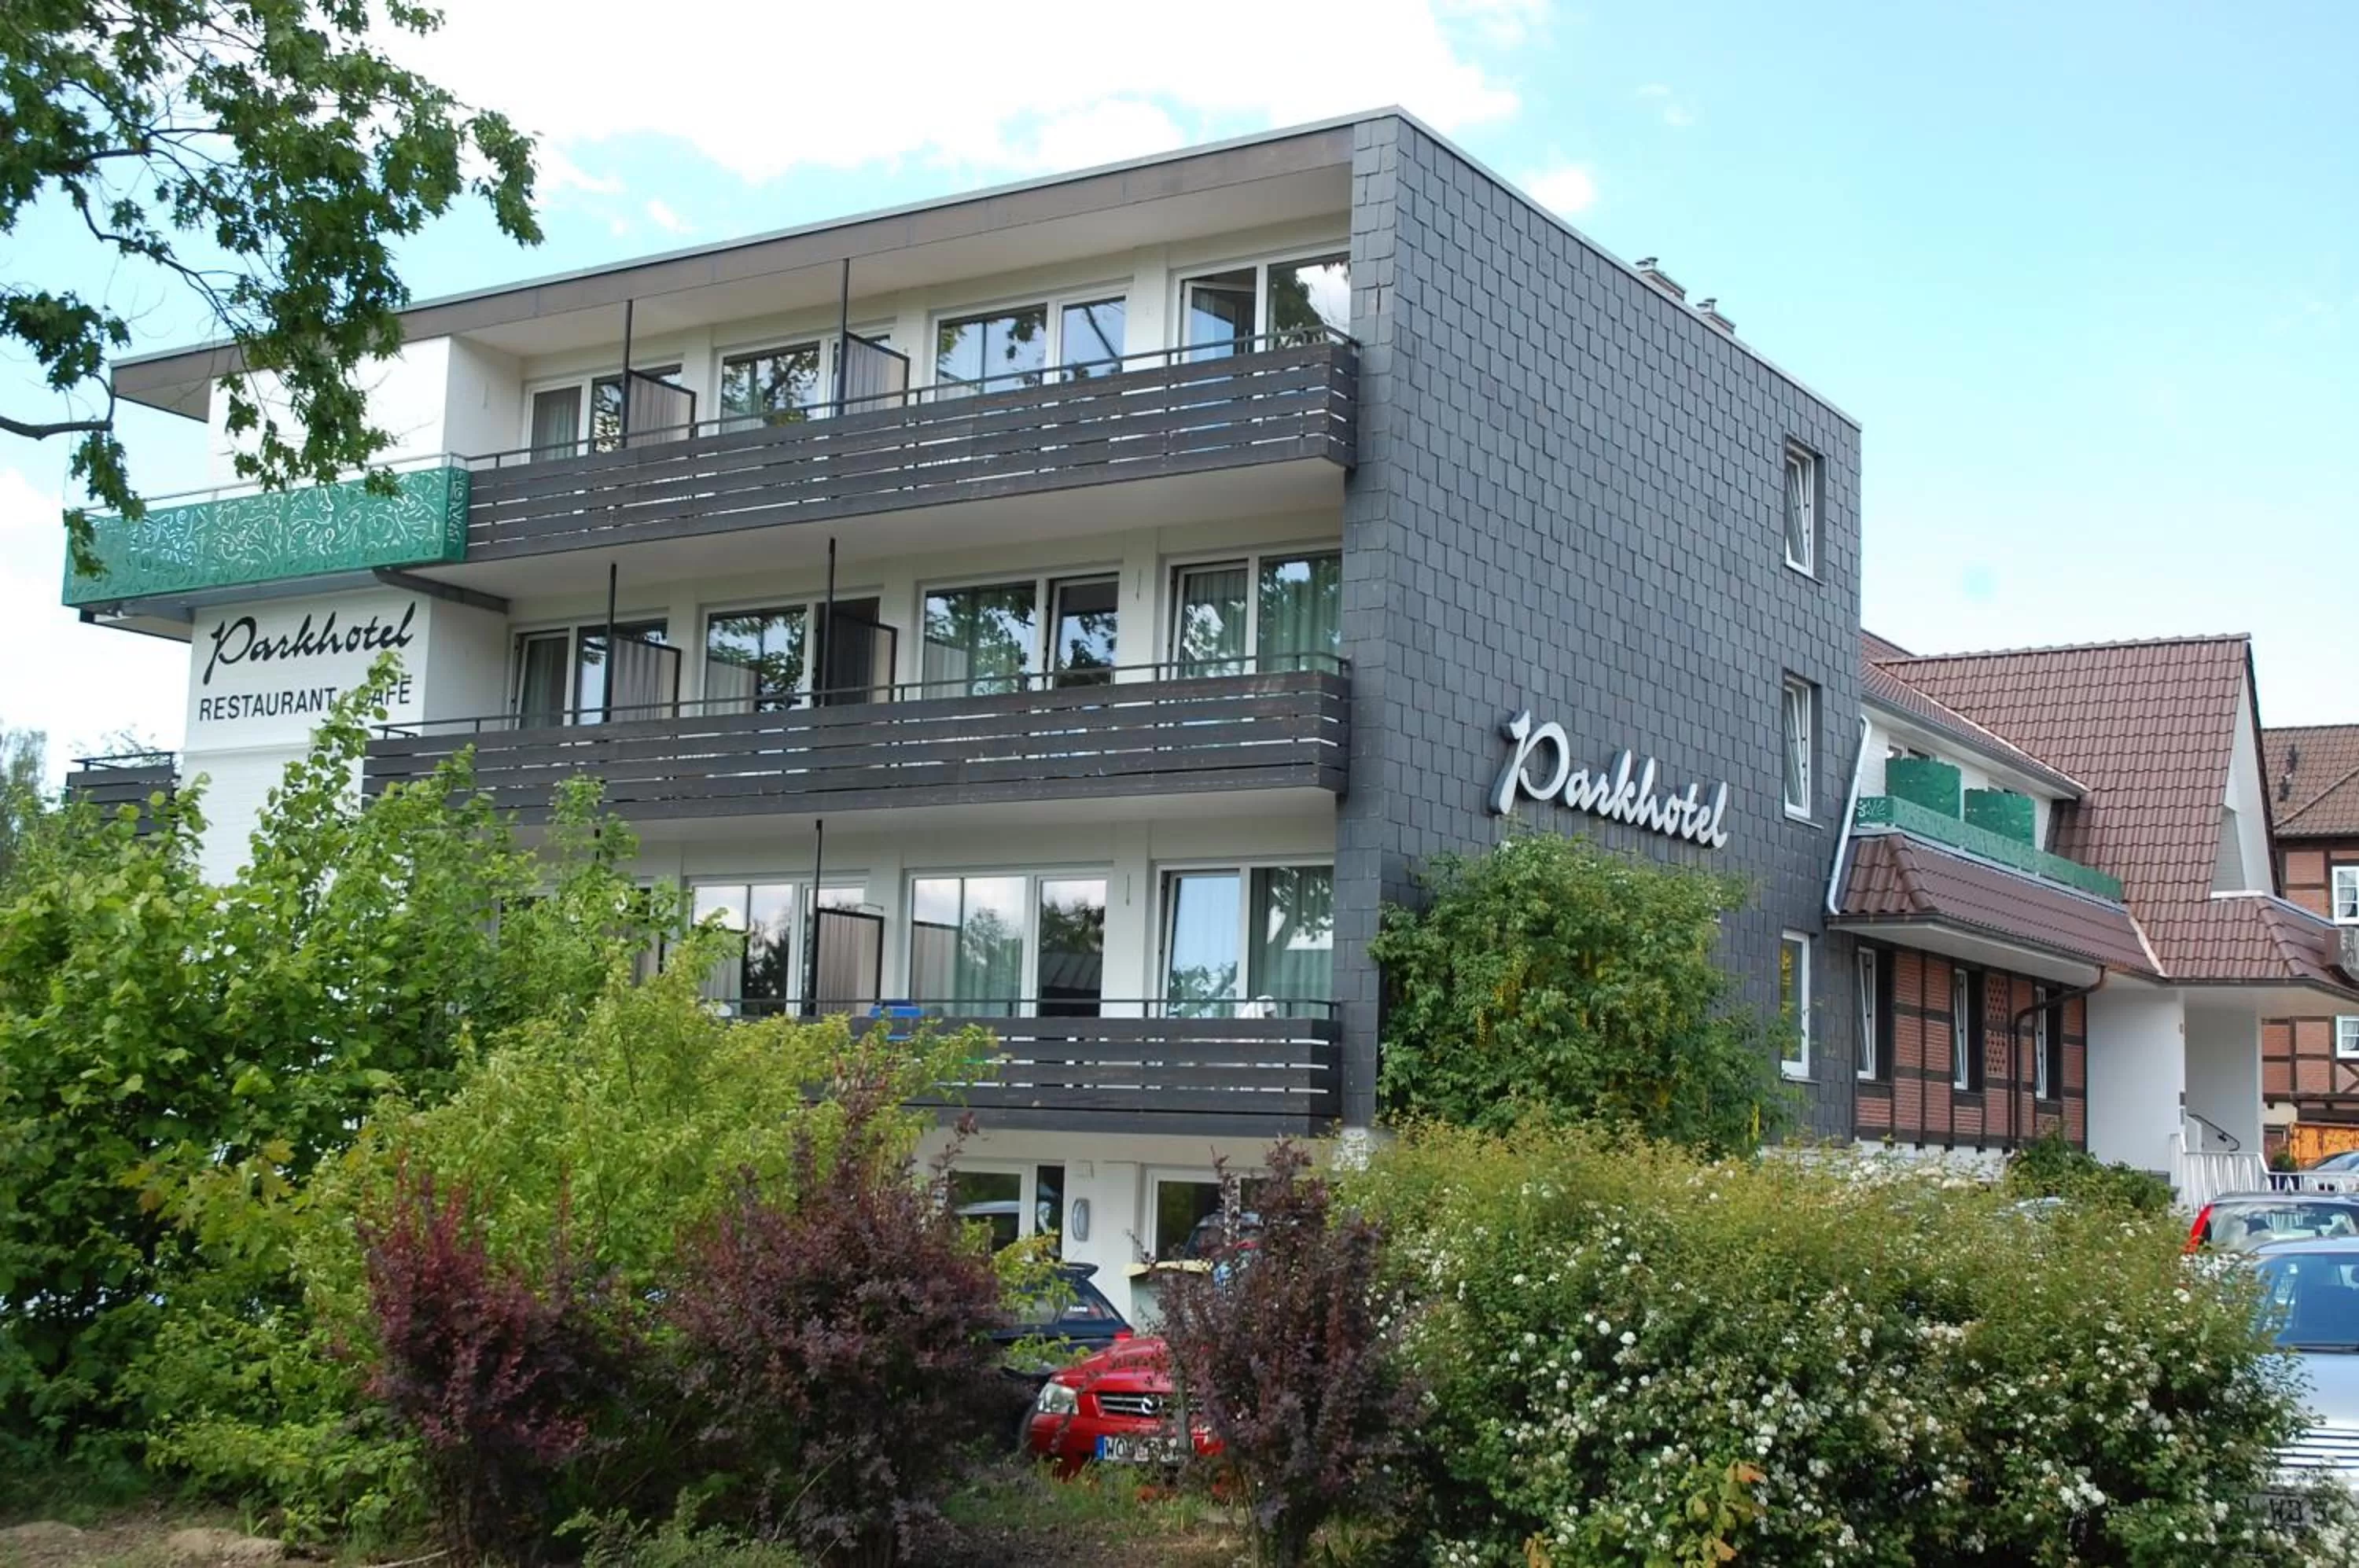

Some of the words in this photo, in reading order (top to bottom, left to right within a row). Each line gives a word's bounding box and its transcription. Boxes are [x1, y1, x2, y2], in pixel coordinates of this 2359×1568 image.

[202, 601, 416, 686] Parkhotel
[199, 686, 337, 721] RESTAURANT
[1492, 709, 1728, 848] Parkhotel
